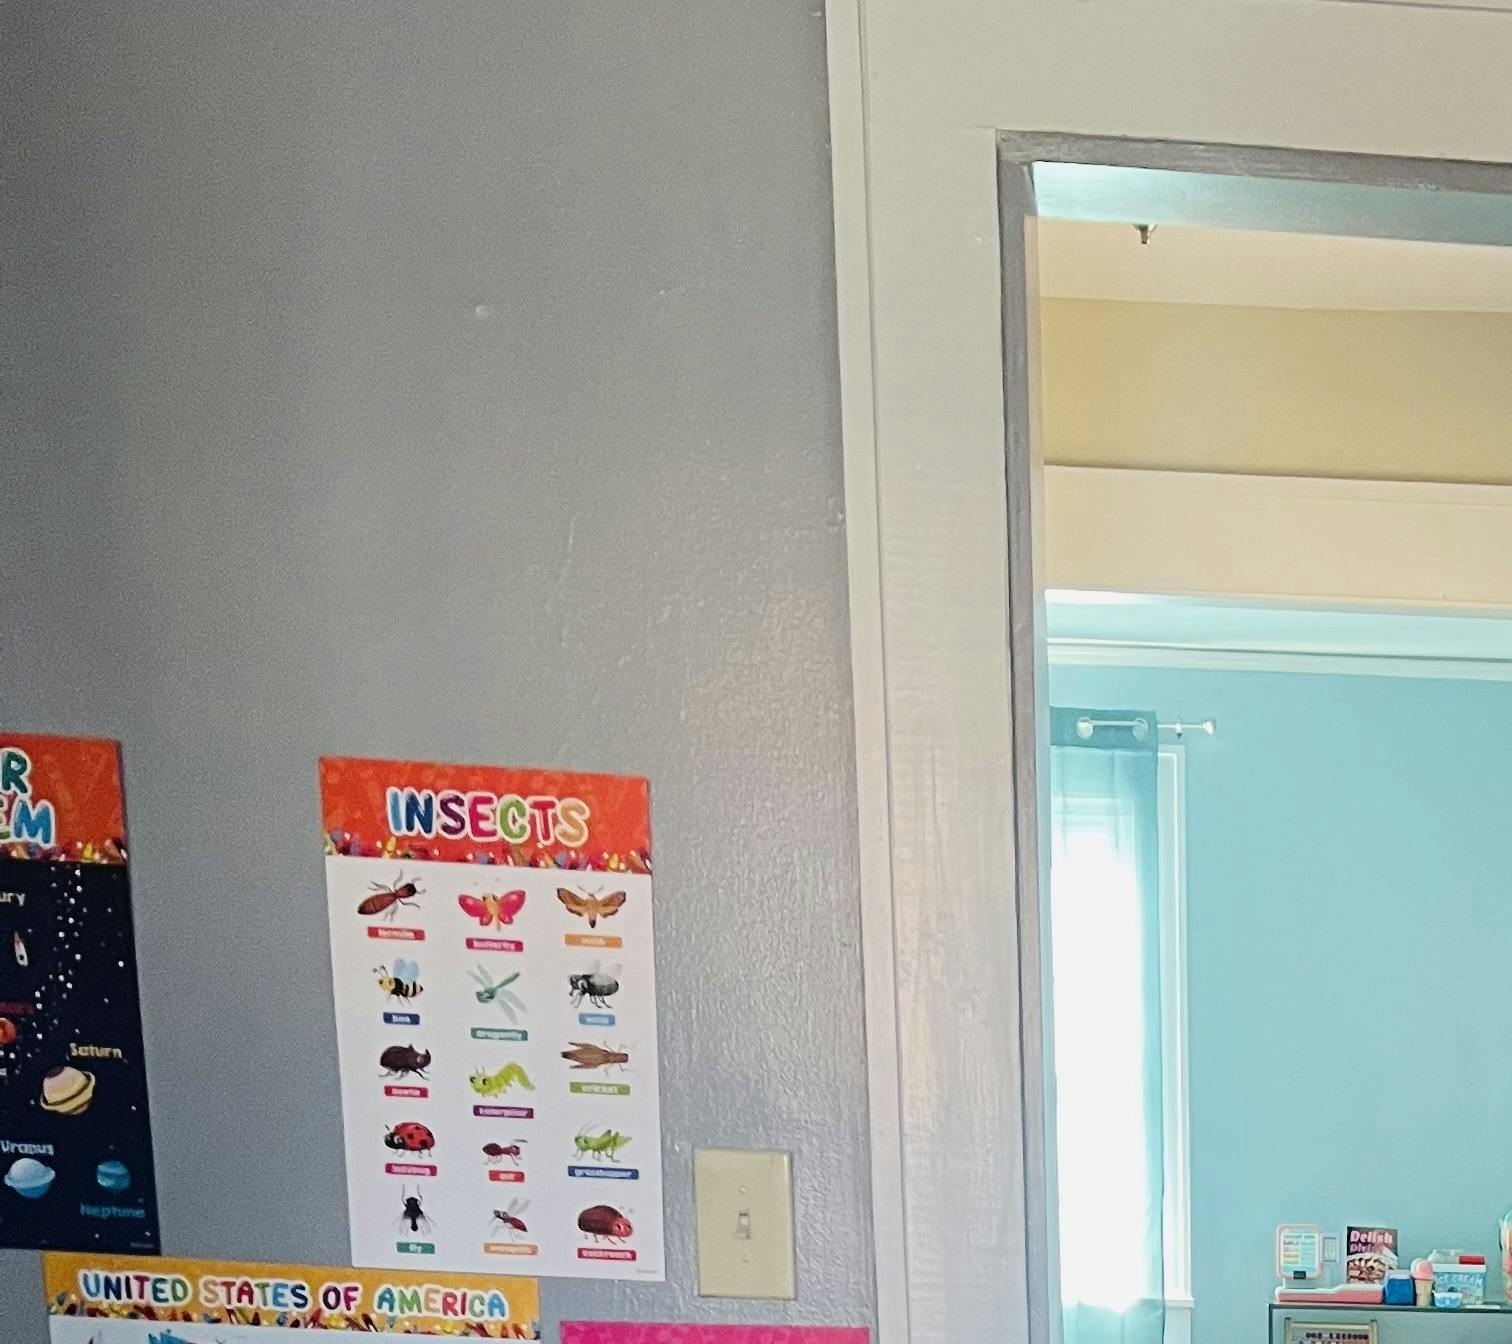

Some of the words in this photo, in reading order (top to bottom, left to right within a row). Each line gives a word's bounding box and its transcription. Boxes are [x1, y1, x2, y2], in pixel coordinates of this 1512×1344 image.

[386, 786, 591, 847] INSECTS
[69, 1042, 122, 1059] Saturn
[1, 1140, 54, 1156] Uranus
[80, 1202, 146, 1220] Neptune
[78, 1269, 192, 1308] UNITED
[199, 1275, 312, 1311] STATES
[319, 1280, 361, 1316] OF
[373, 1283, 509, 1321] AMERICA
